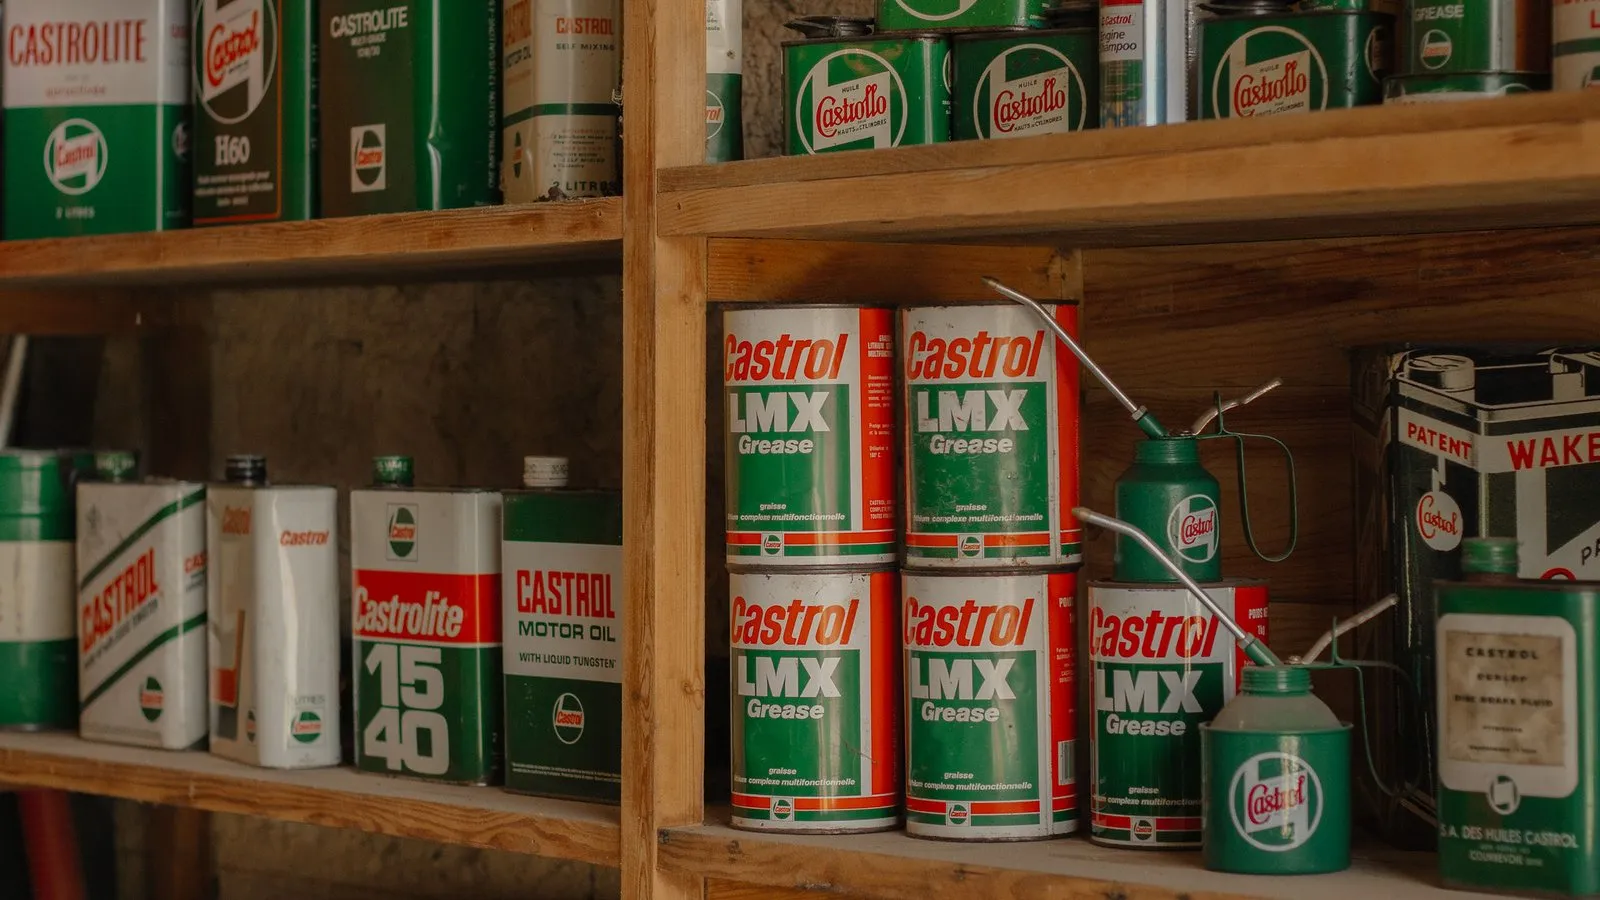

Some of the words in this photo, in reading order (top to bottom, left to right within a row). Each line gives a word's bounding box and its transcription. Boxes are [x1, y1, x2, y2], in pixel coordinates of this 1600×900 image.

[330, 6, 408, 38] CASTROLITE
[1104, 14, 1132, 26] Castrol
[1414, 4, 1464, 21] GREASE
[556, 17, 614, 35] CASTROL
[8, 19, 147, 67] CASTROLITE
[206, 10, 259, 88] Castrol
[841, 84, 859, 94] HUILE
[1018, 79, 1037, 89] HUILE
[816, 83, 887, 138] Castrollo
[994, 77, 1065, 133] Castrollo
[837, 126, 855, 136] HAUTS
[859, 118, 887, 131] CYLINDRES
[1035, 115, 1063, 127] CYLINDRES
[214, 135, 250, 166] H60
[725, 333, 849, 382] Castrol
[906, 330, 1045, 381] Castrol
[729, 391, 830, 432] LMX
[917, 389, 1030, 433] LMX
[738, 435, 813, 454] Grease
[929, 435, 1013, 454] Grease
[1407, 421, 1473, 460] PATENT
[1507, 431, 1600, 471] WAKE
[740, 513, 770, 523] complexe
[771, 512, 845, 521] multifonctionnelle
[759, 502, 787, 512] graisse
[931, 514, 967, 524] complexe
[968, 513, 1043, 523] multifonctionnelle
[955, 503, 987, 513] graisse
[1418, 494, 1458, 540] Castrol
[280, 530, 329, 547] Castrol
[1181, 510, 1215, 545] Castrol
[82, 546, 158, 654] CASTROL
[516, 569, 616, 620] CASTROL
[353, 585, 464, 639] Castrolite
[731, 596, 860, 646] Castrol
[904, 596, 1035, 647] Castrol
[518, 620, 584, 640] MOTOR
[589, 624, 616, 643] OIL
[1090, 606, 1219, 659] Castrol
[519, 652, 542, 665] WITH
[543, 654, 572, 667] LIQUID
[1465, 647, 1539, 660] CASTROL
[364, 643, 444, 710] 15
[738, 655, 841, 698] LMX
[911, 657, 1016, 700] LMX
[1096, 669, 1204, 714] LMX
[556, 711, 584, 726] Castrol
[747, 699, 825, 720] Grease
[921, 701, 1000, 723] Grease
[1106, 714, 1187, 737] Grease
[364, 706, 450, 776] 40
[748, 776, 781, 788] complexe
[781, 776, 856, 787] multifonctionnelle
[768, 767, 797, 776] graisse
[943, 771, 974, 781] graisse
[923, 781, 955, 792] complexe
[955, 781, 1033, 792] multifonctionnelle
[1128, 786, 1159, 796] graisse
[1107, 796, 1140, 806] complexe
[1247, 774, 1306, 825] Castrol
[1461, 825, 1483, 840] DES
[1485, 827, 1522, 843] HUILES
[1524, 829, 1579, 849] CASTROL
